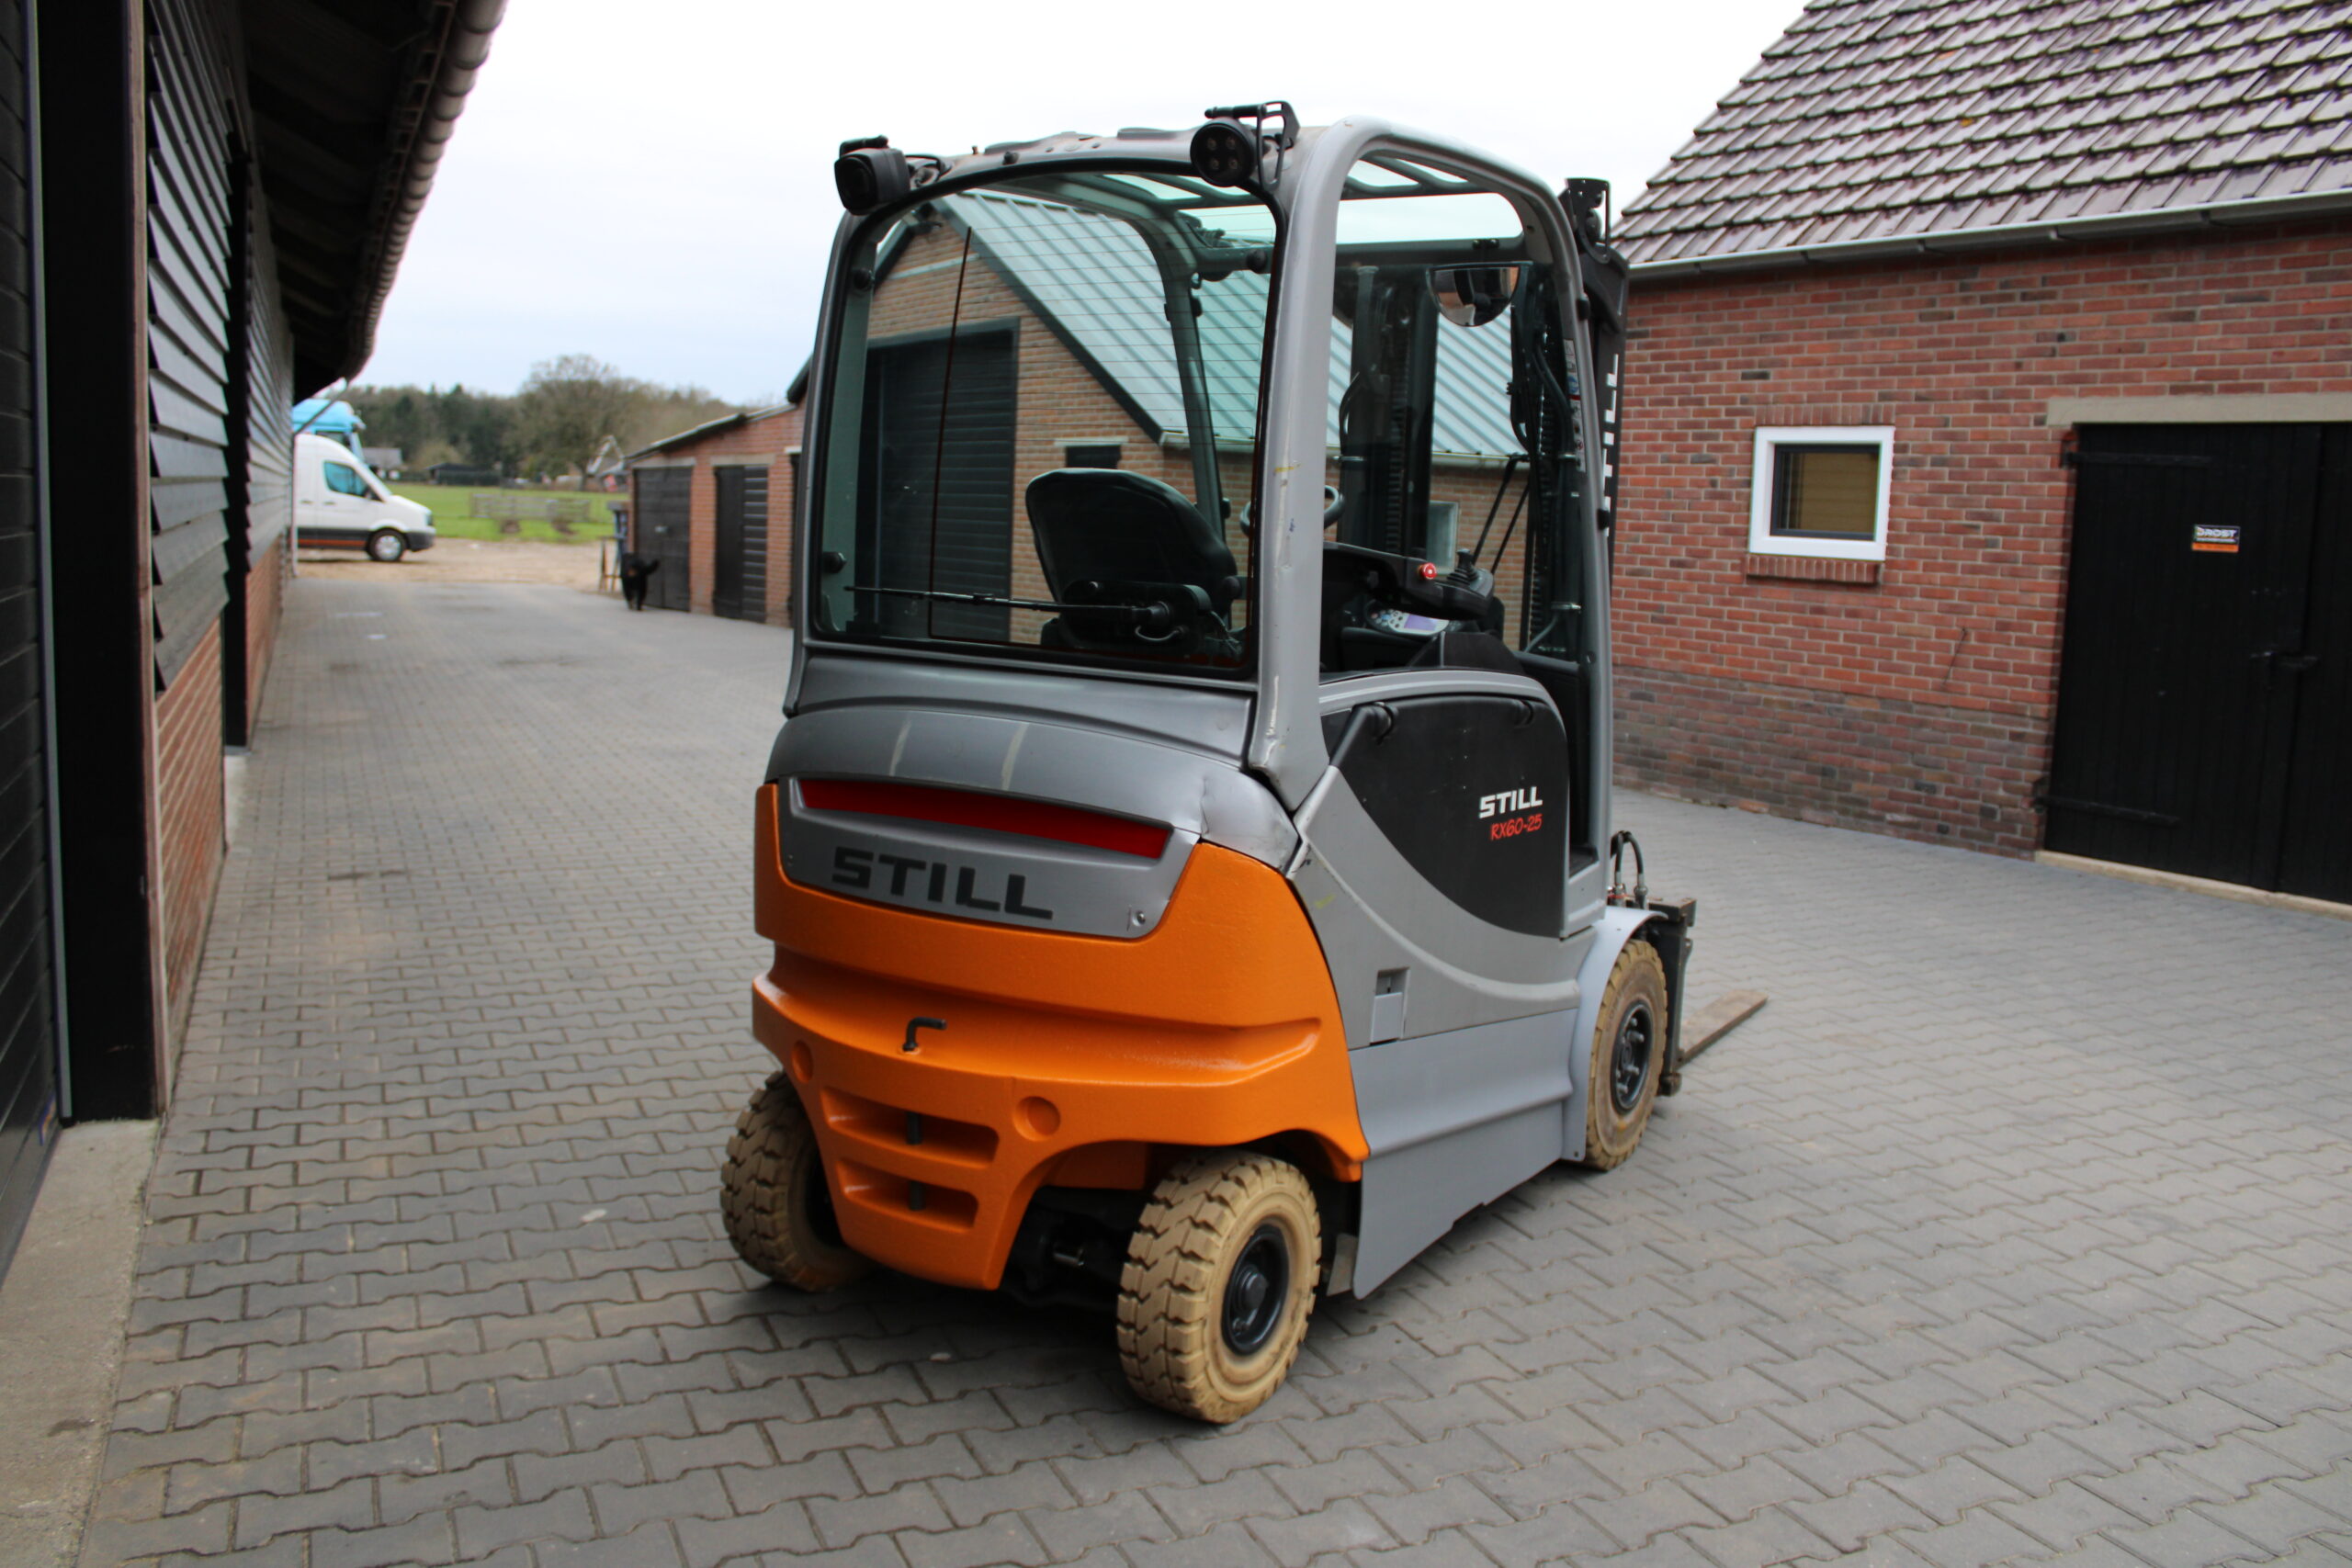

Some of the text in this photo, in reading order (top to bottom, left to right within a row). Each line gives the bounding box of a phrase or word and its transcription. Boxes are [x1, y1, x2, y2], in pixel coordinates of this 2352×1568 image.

[2196, 526, 2237, 537] DROST
[1478, 786, 1544, 819] STILL
[1490, 814, 1543, 840] RX60-25
[831, 846, 1054, 920] STILL
